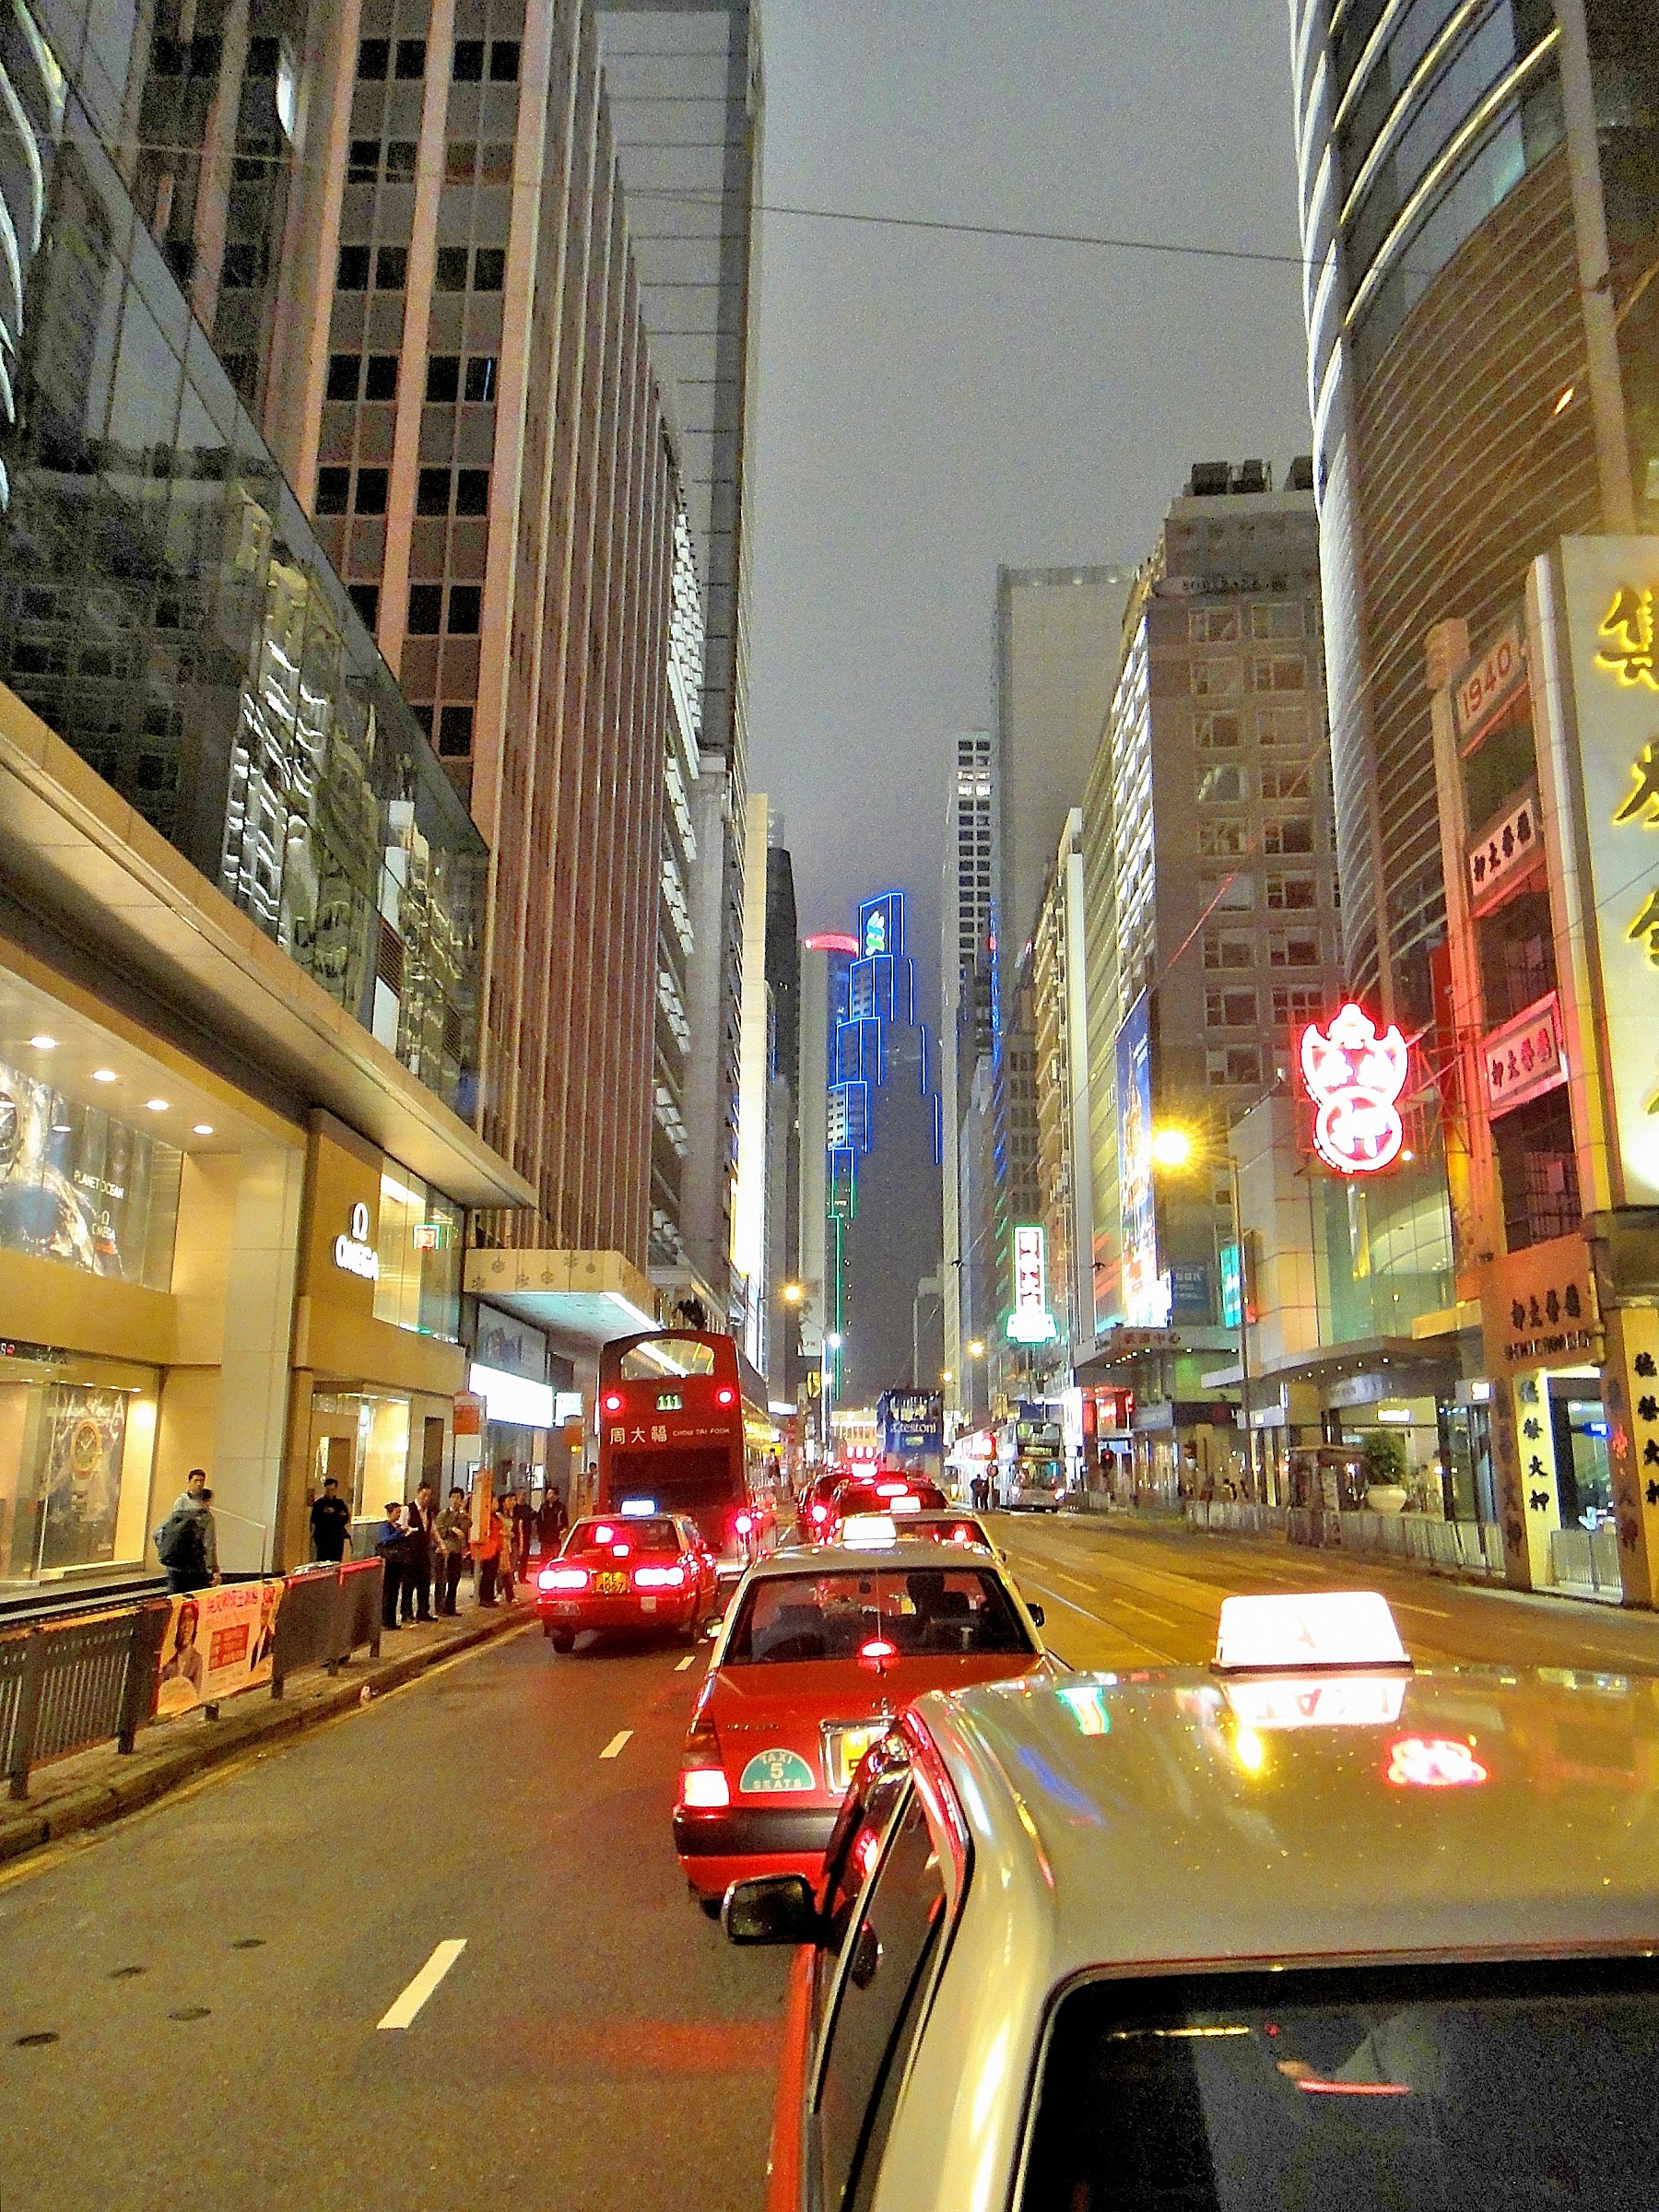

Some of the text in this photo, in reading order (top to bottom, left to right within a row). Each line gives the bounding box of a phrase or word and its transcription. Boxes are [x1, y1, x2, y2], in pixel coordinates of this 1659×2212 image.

[1463, 641, 1512, 720] 1940
[74, 1170, 125, 1199] PLANET OCEAN
[335, 1234, 380, 1282] OMEGA
[655, 1394, 683, 1411] 111
[609, 1425, 668, 1445] 周大福
[696, 1428, 708, 1436] TAI
[710, 1427, 730, 1435] FOOK
[605, 1573, 618, 1583] KE
[760, 1753, 793, 1765] TAXI
[770, 1762, 784, 1780] 5
[752, 1778, 803, 1790] SEATS
